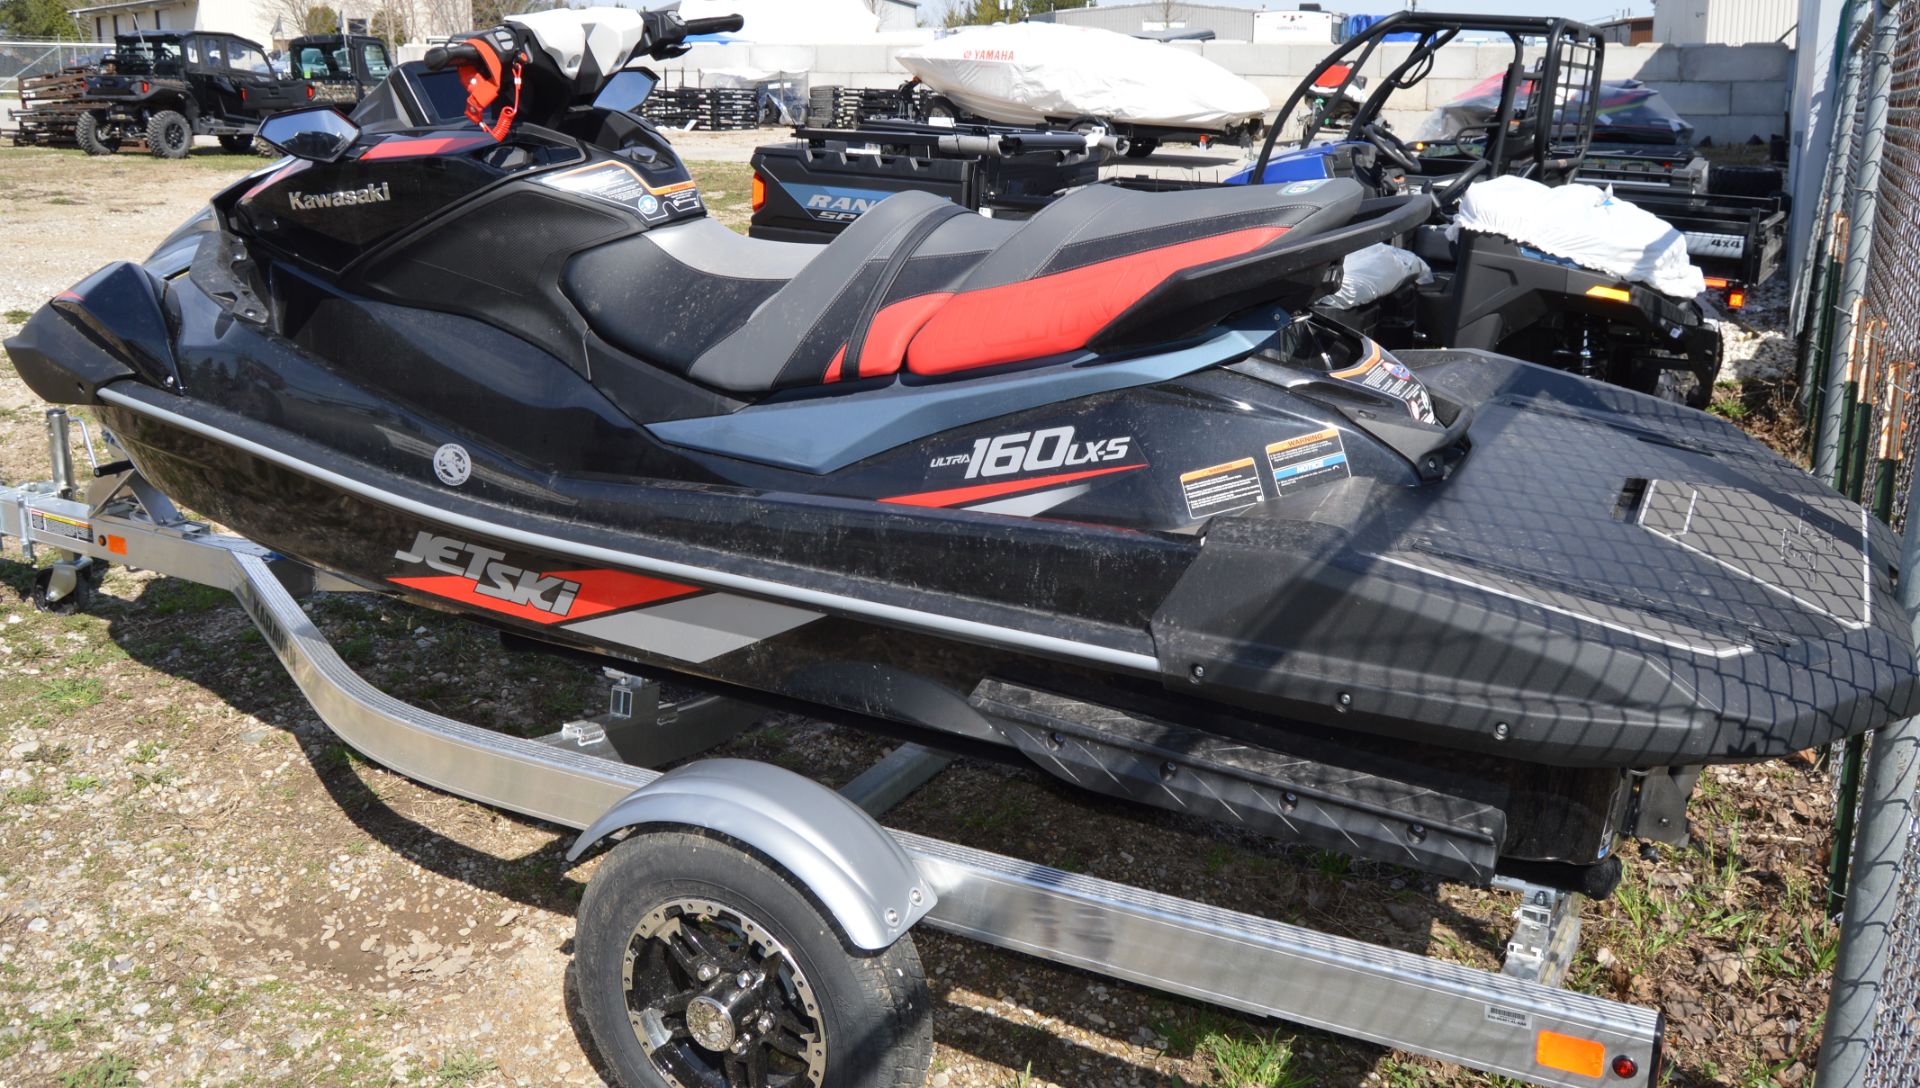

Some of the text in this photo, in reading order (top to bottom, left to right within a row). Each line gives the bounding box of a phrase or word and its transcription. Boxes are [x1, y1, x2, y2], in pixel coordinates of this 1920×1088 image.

[975, 49, 1014, 61] YAMAHA
[288, 182, 391, 210] Kawasaki
[1711, 239, 1740, 249] 4x4
[1288, 432, 1324, 447] WARNING
[929, 425, 1131, 480] ULTRA 160 LX-S
